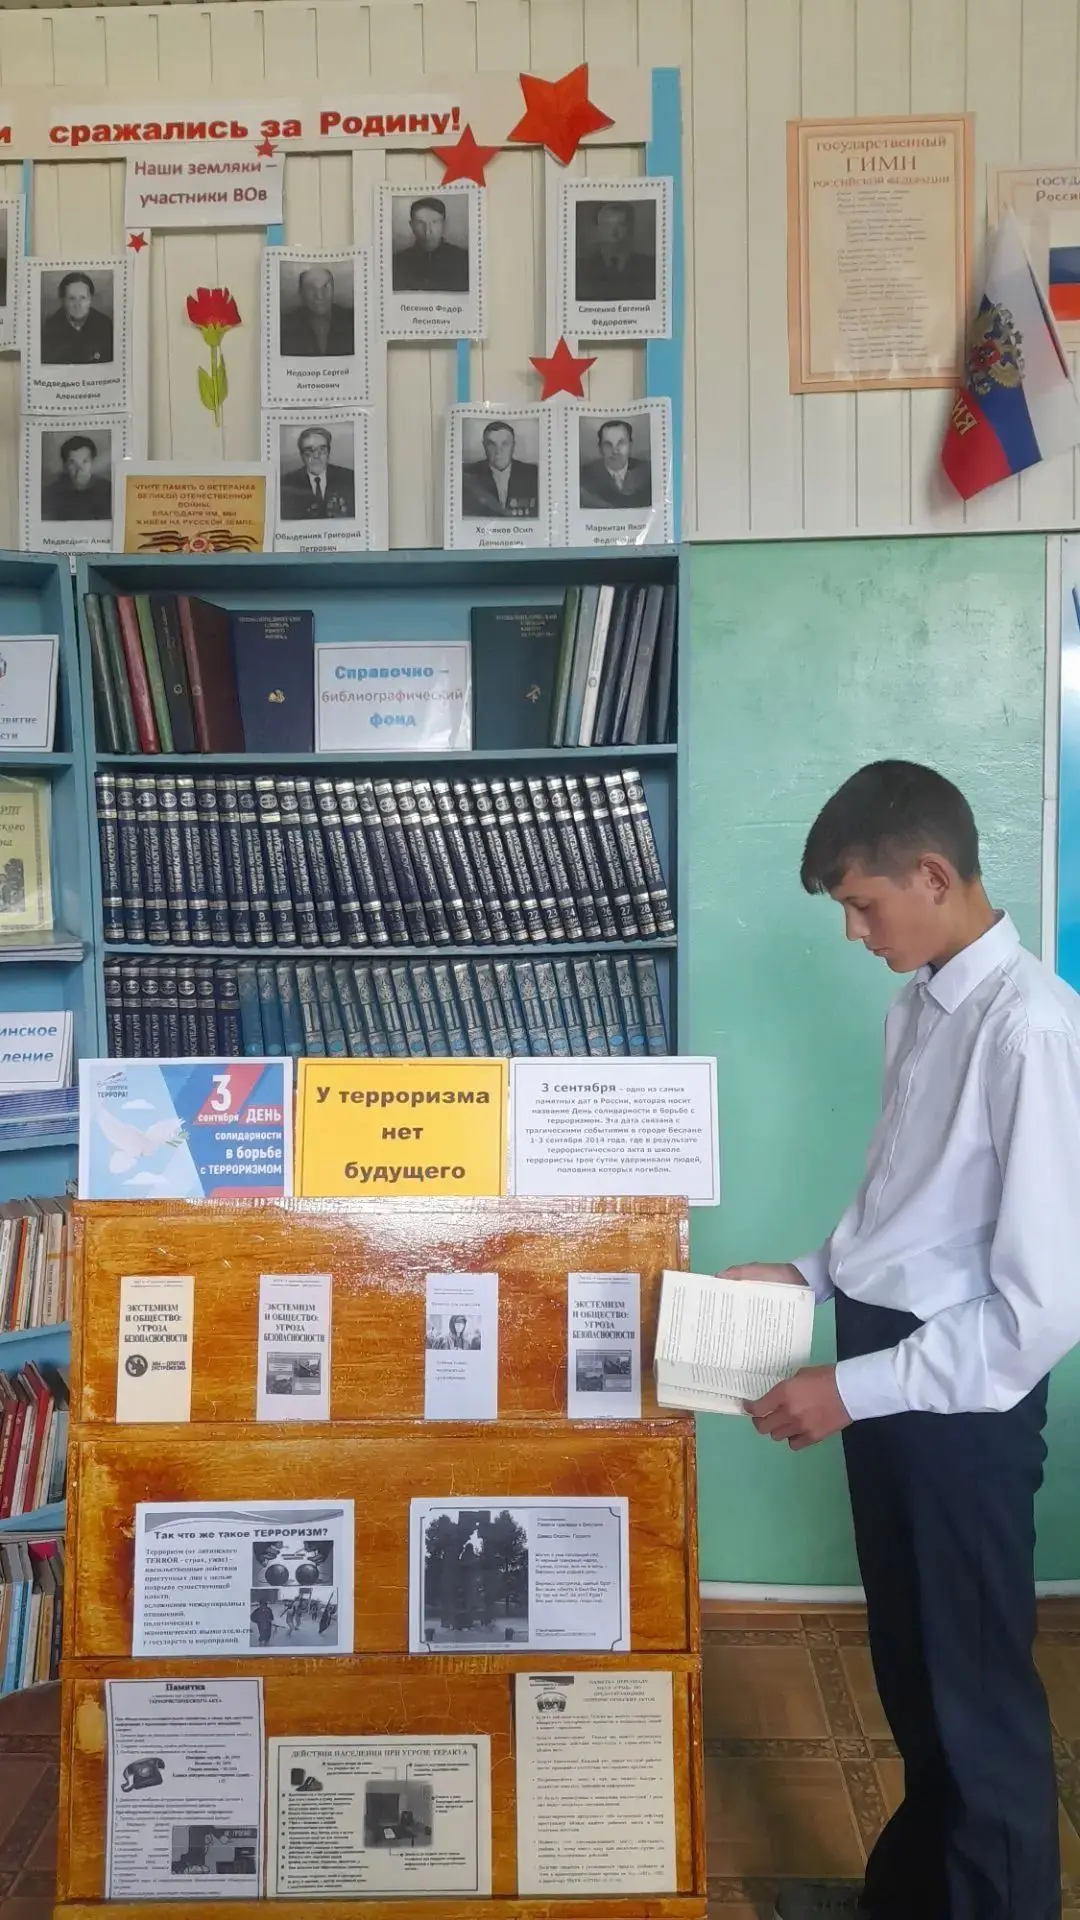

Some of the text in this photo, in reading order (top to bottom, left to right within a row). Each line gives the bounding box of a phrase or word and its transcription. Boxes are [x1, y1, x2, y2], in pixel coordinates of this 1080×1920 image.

[50, 120, 249, 147] сражались
[260, 119, 303, 137] за
[319, 107, 461, 136] Родину!
[134, 161, 183, 175] Наши
[188, 161, 262, 175] земляки
[846, 155, 917, 173] ГИМН
[140, 187, 268, 208] участники ВОв
[335, 665, 434, 681] Справочно
[321, 688, 463, 703] библиографический
[369, 712, 417, 728] фонд
[154, 910, 161, 920] 3
[258, 911, 266, 920] 8
[280, 912, 287, 921] 9
[211, 1074, 232, 1112] 3
[541, 1083, 549, 1092] 3
[554, 1083, 617, 1095] сентября
[316, 1086, 490, 1108] У терроризма
[577, 1097, 592, 1106] дат
[633, 1097, 666, 1106] которая
[668, 1097, 692, 1105] носит
[198, 1108, 281, 1125] сентября ДЕНЬ
[571, 1106, 592, 1116] День
[620, 1117, 640, 1126] дата
[215, 1131, 282, 1141] солидарности
[382, 1126, 424, 1140] нет
[637, 1127, 666, 1136] городе
[545, 1136, 583, 1145] сентября
[226, 1146, 282, 1161] в борьбе
[200, 1164, 282, 1175] с ТЕРРОРИЗМОМ
[344, 1161, 466, 1184] будущего
[137, 1324, 168, 1332] УГРОЗА
[275, 1323, 306, 1333] УГРОЗА
[584, 1321, 615, 1330] УГРОЗА
[154, 1527, 329, 1540] Так что же такое ТЕРРОРИЗМ?
